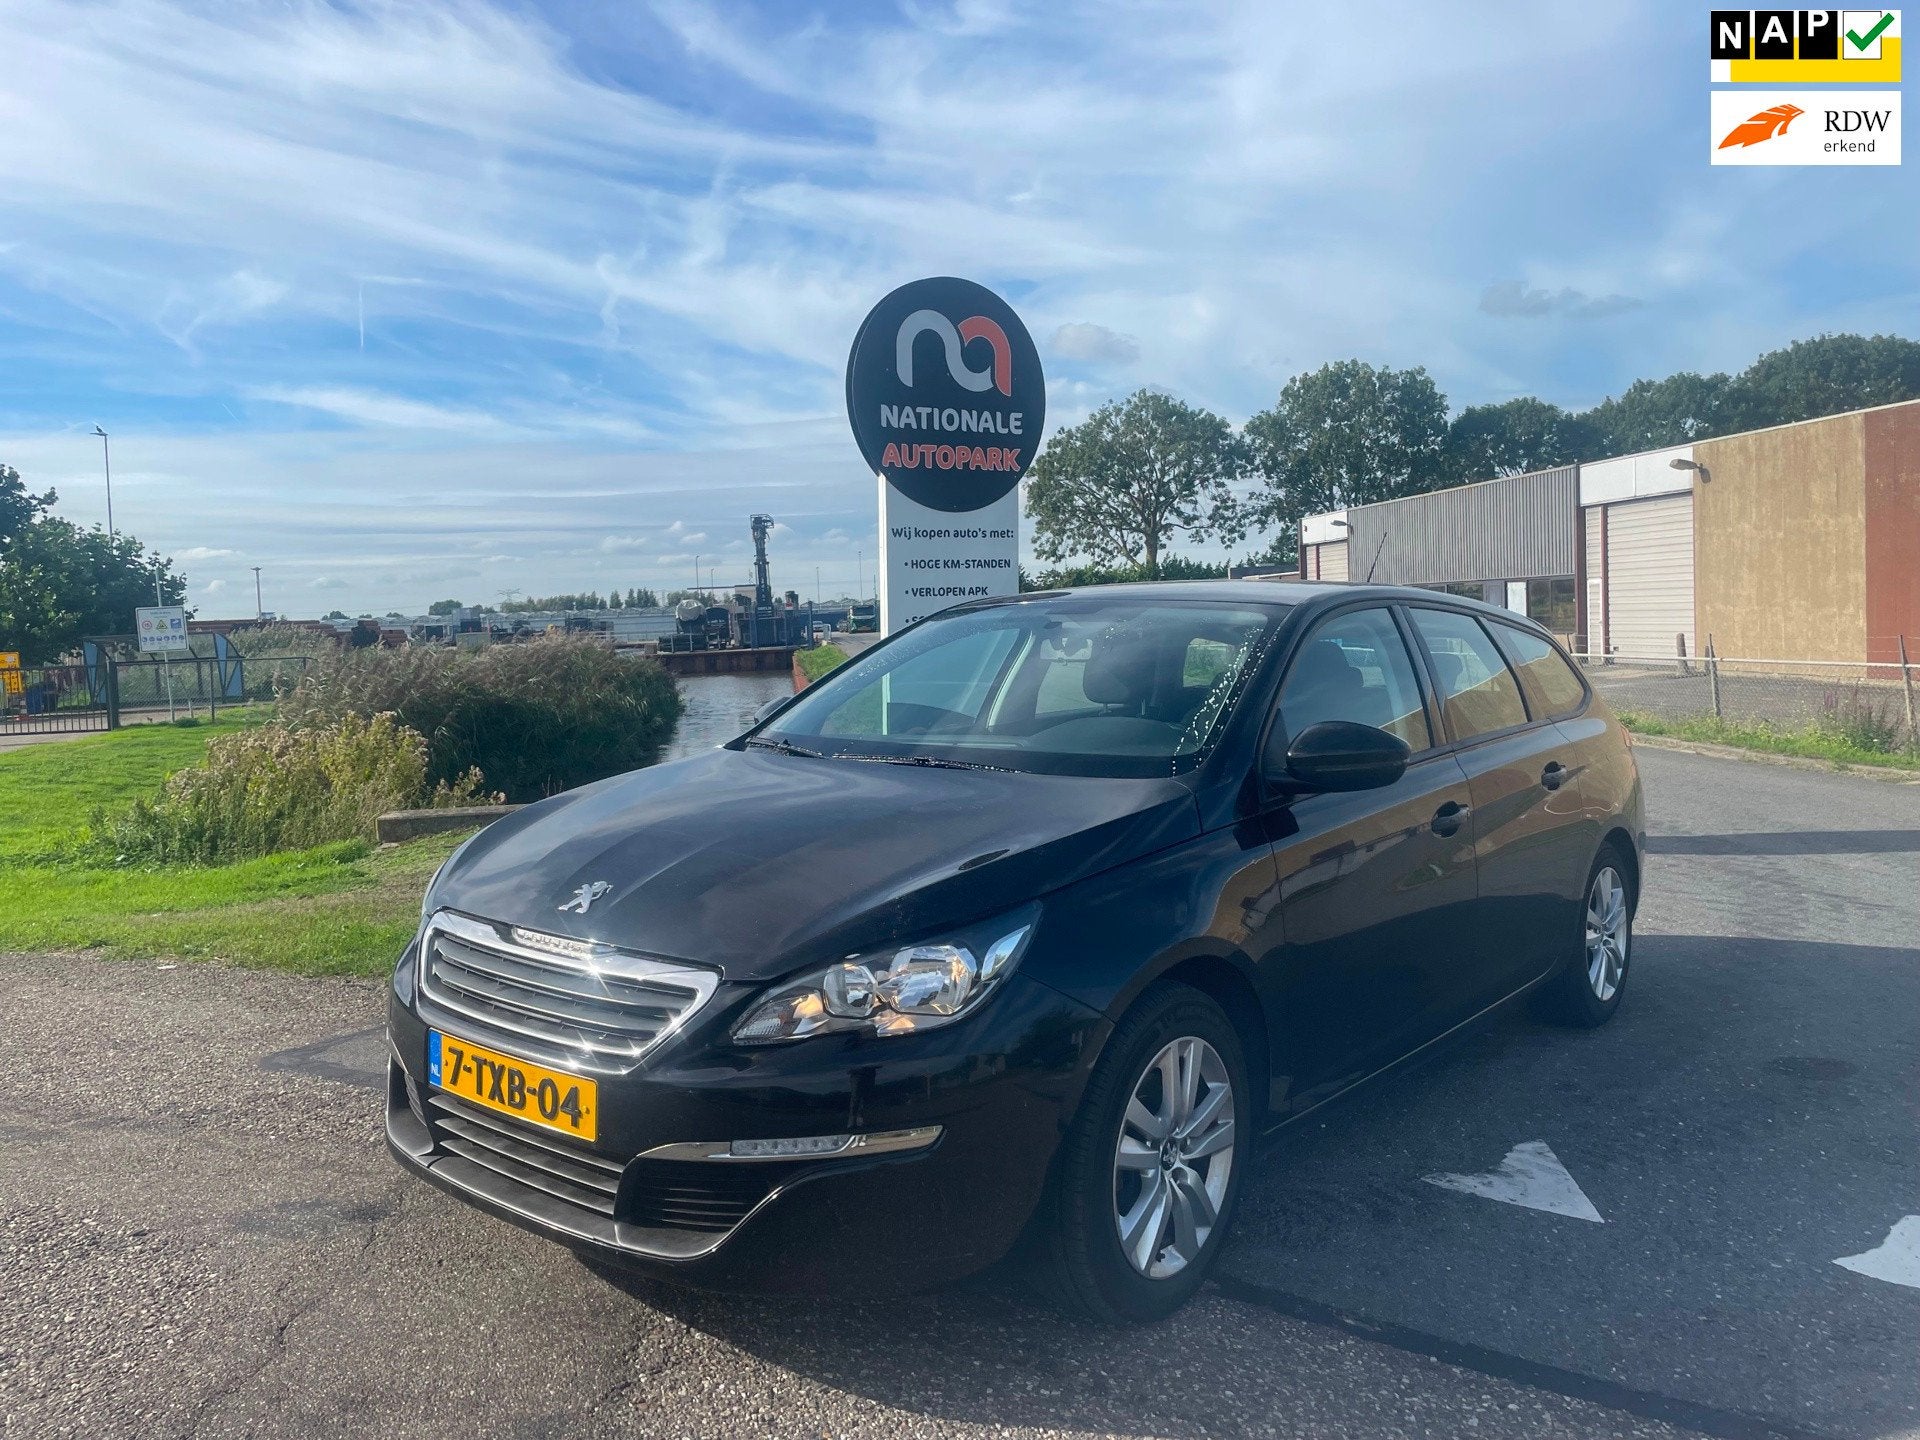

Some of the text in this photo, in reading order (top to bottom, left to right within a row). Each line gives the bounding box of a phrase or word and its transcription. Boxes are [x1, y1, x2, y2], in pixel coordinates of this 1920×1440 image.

[880, 404, 1023, 435] NATIONALE
[881, 442, 1021, 472] AUTOPARK
[891, 527, 1014, 540] Wij kopen auto's met:
[911, 559, 1011, 569] HOGE KM-STANDEN
[911, 586, 989, 597] VERLOPEN APK
[448, 1046, 584, 1129] 7-TXB-04
